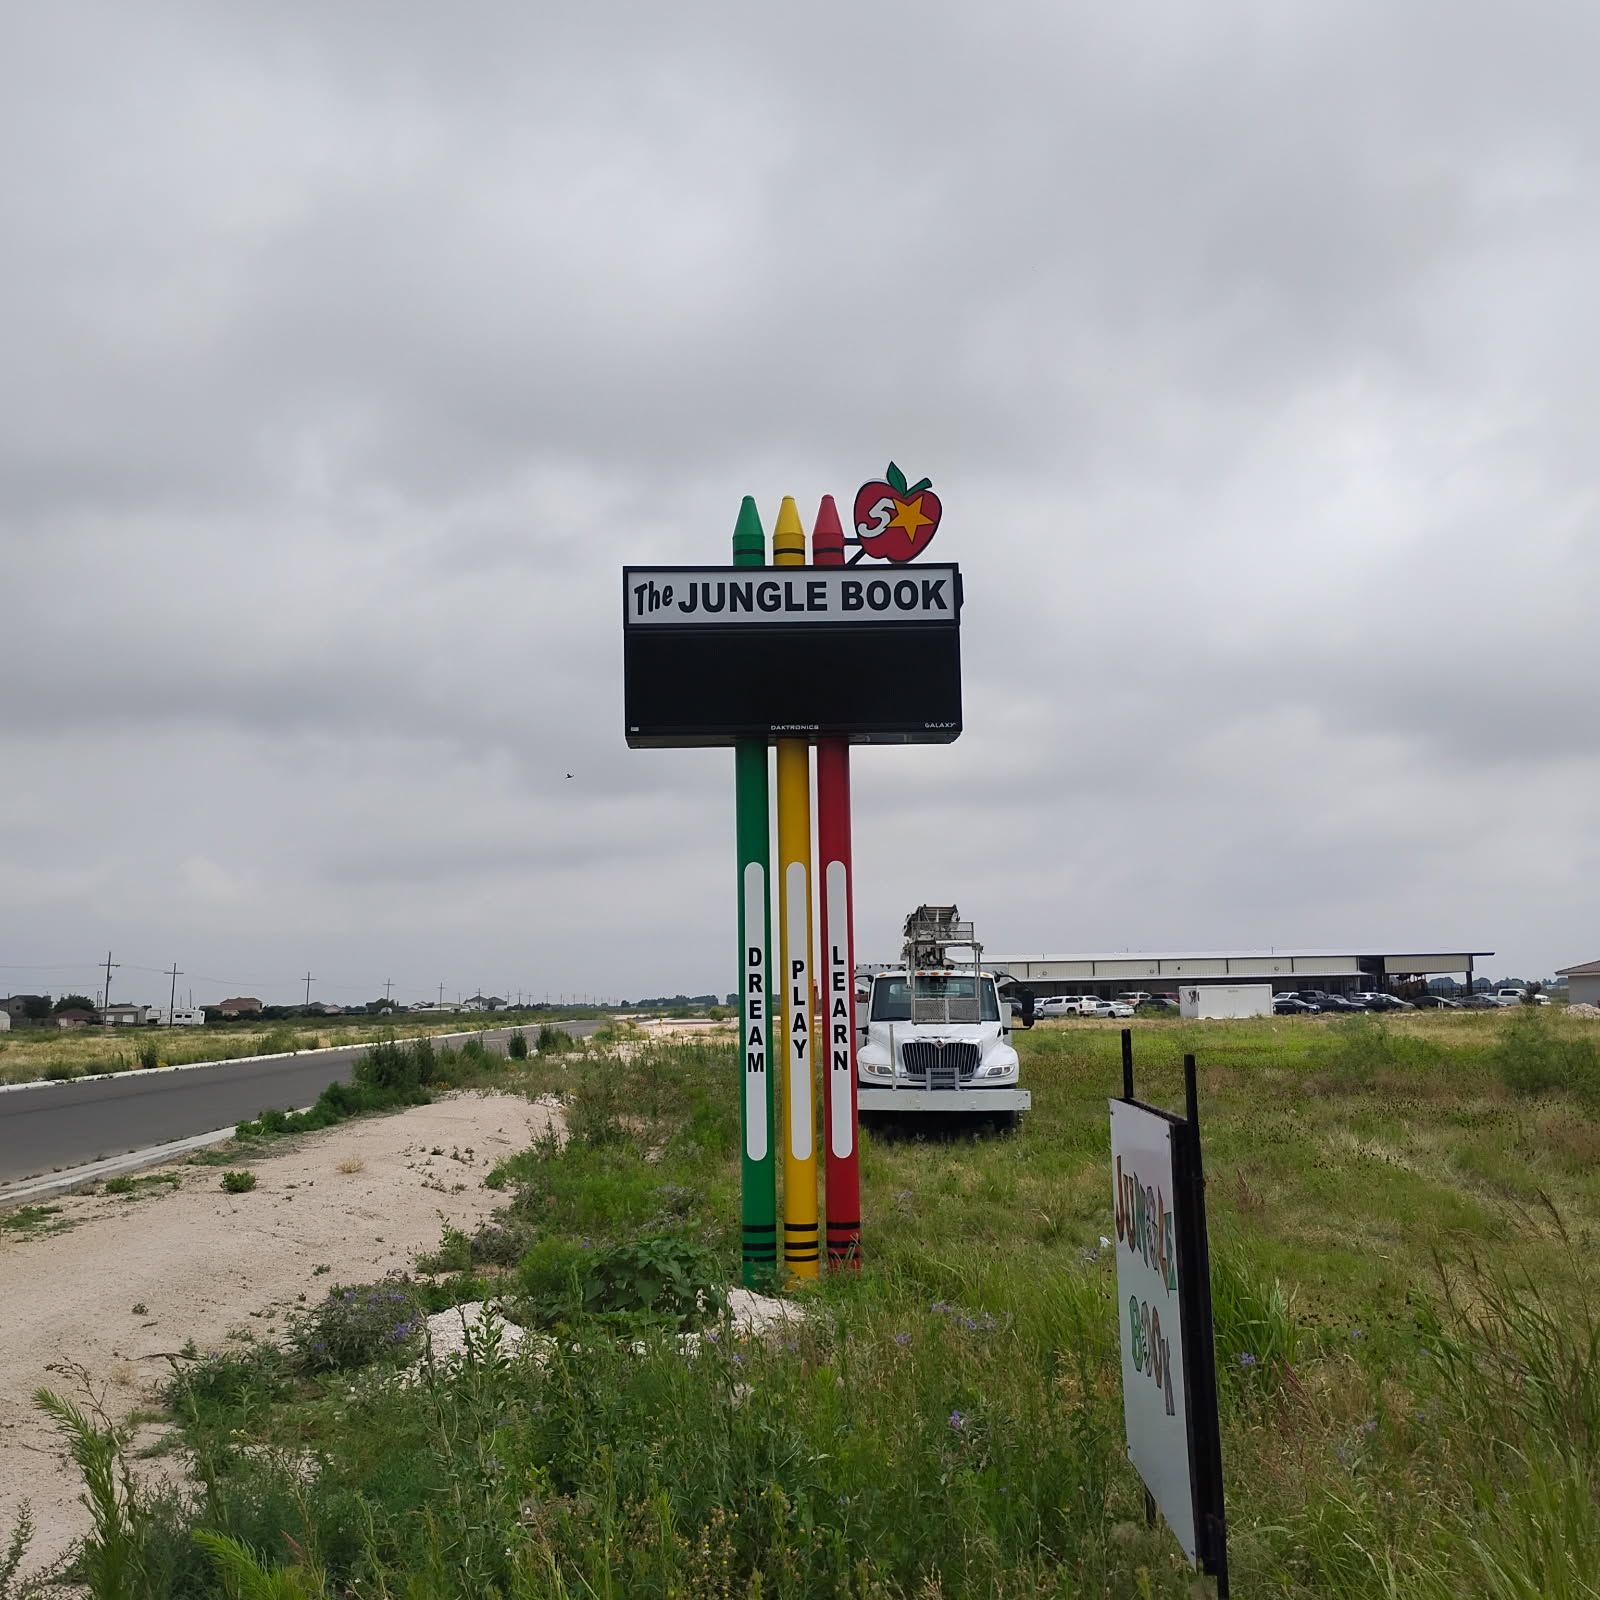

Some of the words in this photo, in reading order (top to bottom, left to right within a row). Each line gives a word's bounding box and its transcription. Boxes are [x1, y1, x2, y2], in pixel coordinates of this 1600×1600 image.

[633, 580, 674, 615] The
[678, 581, 828, 613] JUNGLE
[841, 580, 948, 611] BOOK
[748, 947, 764, 1072] DREAM
[792, 960, 807, 1059] PLAY
[832, 946, 848, 1070] LEARN
[1116, 1155, 1177, 1299] JUNGLE
[1129, 1294, 1176, 1416] BOOK
